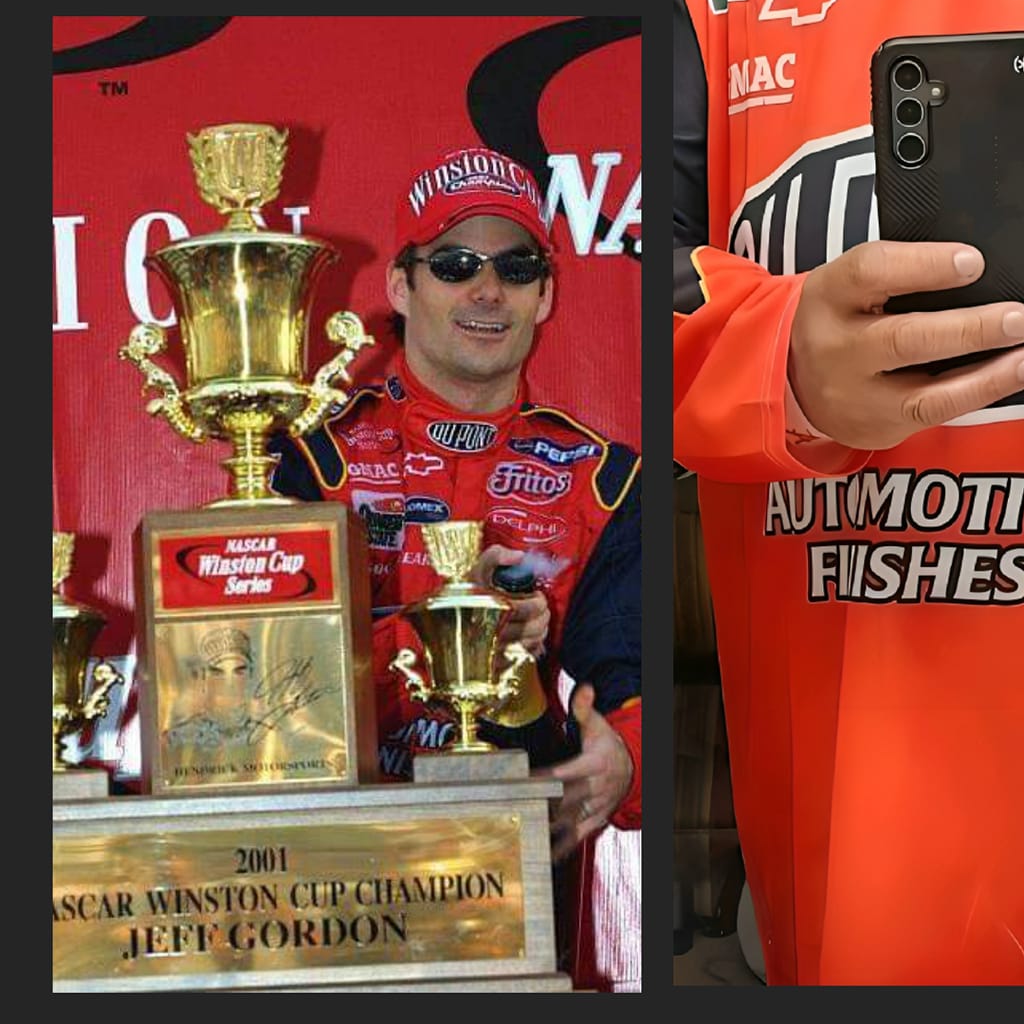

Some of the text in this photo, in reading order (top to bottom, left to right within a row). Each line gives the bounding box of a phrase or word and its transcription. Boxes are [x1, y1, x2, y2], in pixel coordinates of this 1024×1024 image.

[99, 82, 129, 96] TM
[728, 53, 796, 100] MAC
[489, 463, 571, 497] Fritos
[225, 537, 278, 553] NASCAR
[199, 551, 305, 576] Winston Cup
[224, 577, 273, 595] Series
[235, 846, 288, 874] 2001
[147, 884, 279, 917] WINSTON
[289, 880, 346, 910] CUP
[355, 872, 506, 906] CHAMPION
[122, 912, 409, 960] JEFF GORDON
